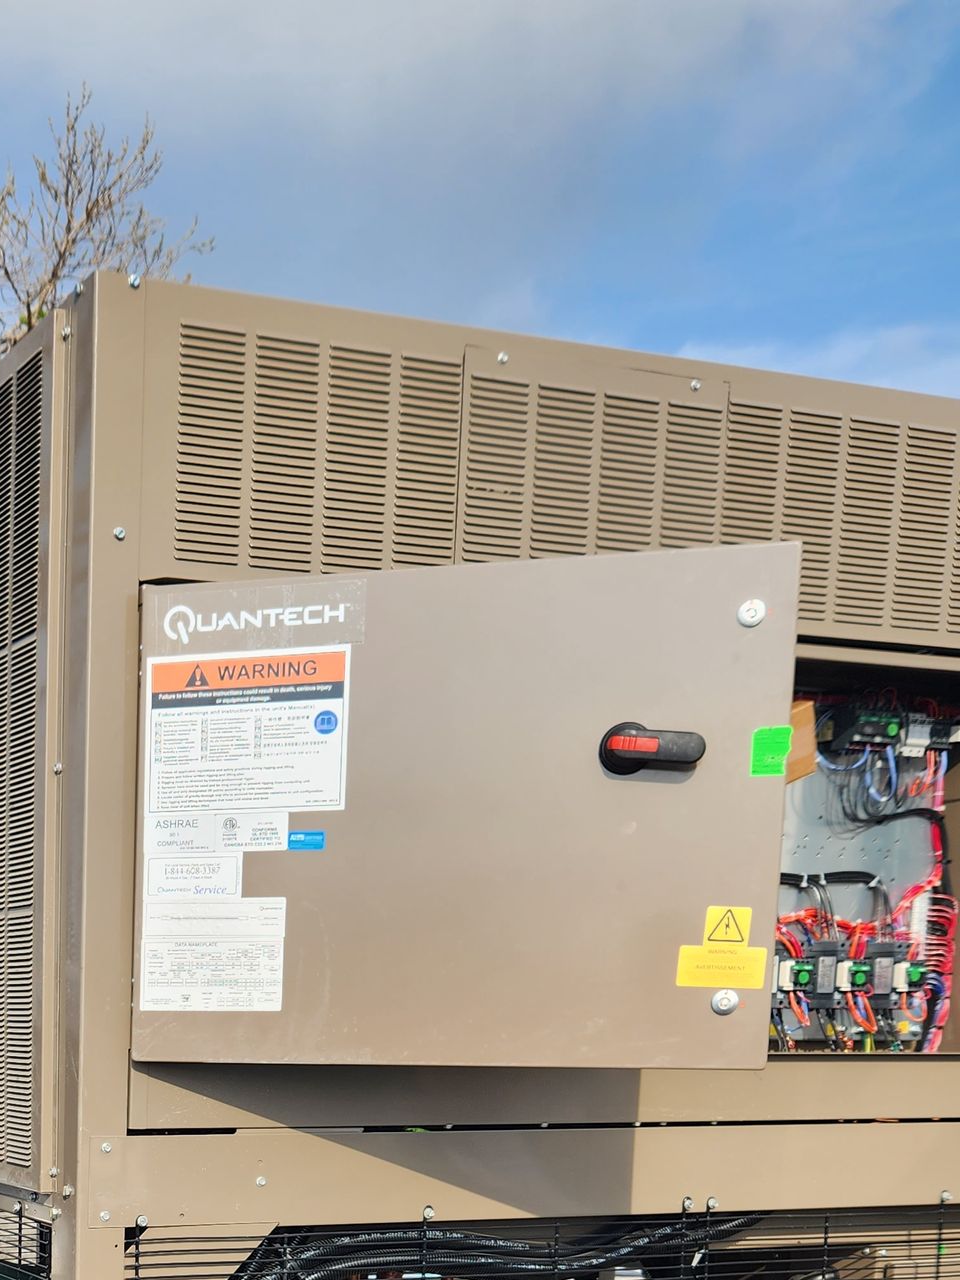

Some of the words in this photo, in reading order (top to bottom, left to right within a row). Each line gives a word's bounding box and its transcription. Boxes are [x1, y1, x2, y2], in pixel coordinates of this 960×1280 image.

[163, 604, 345, 644] QUANTECH
[218, 660, 317, 681] WARNING
[155, 819, 199, 829] ASHRAE
[193, 885, 227, 895] Service
